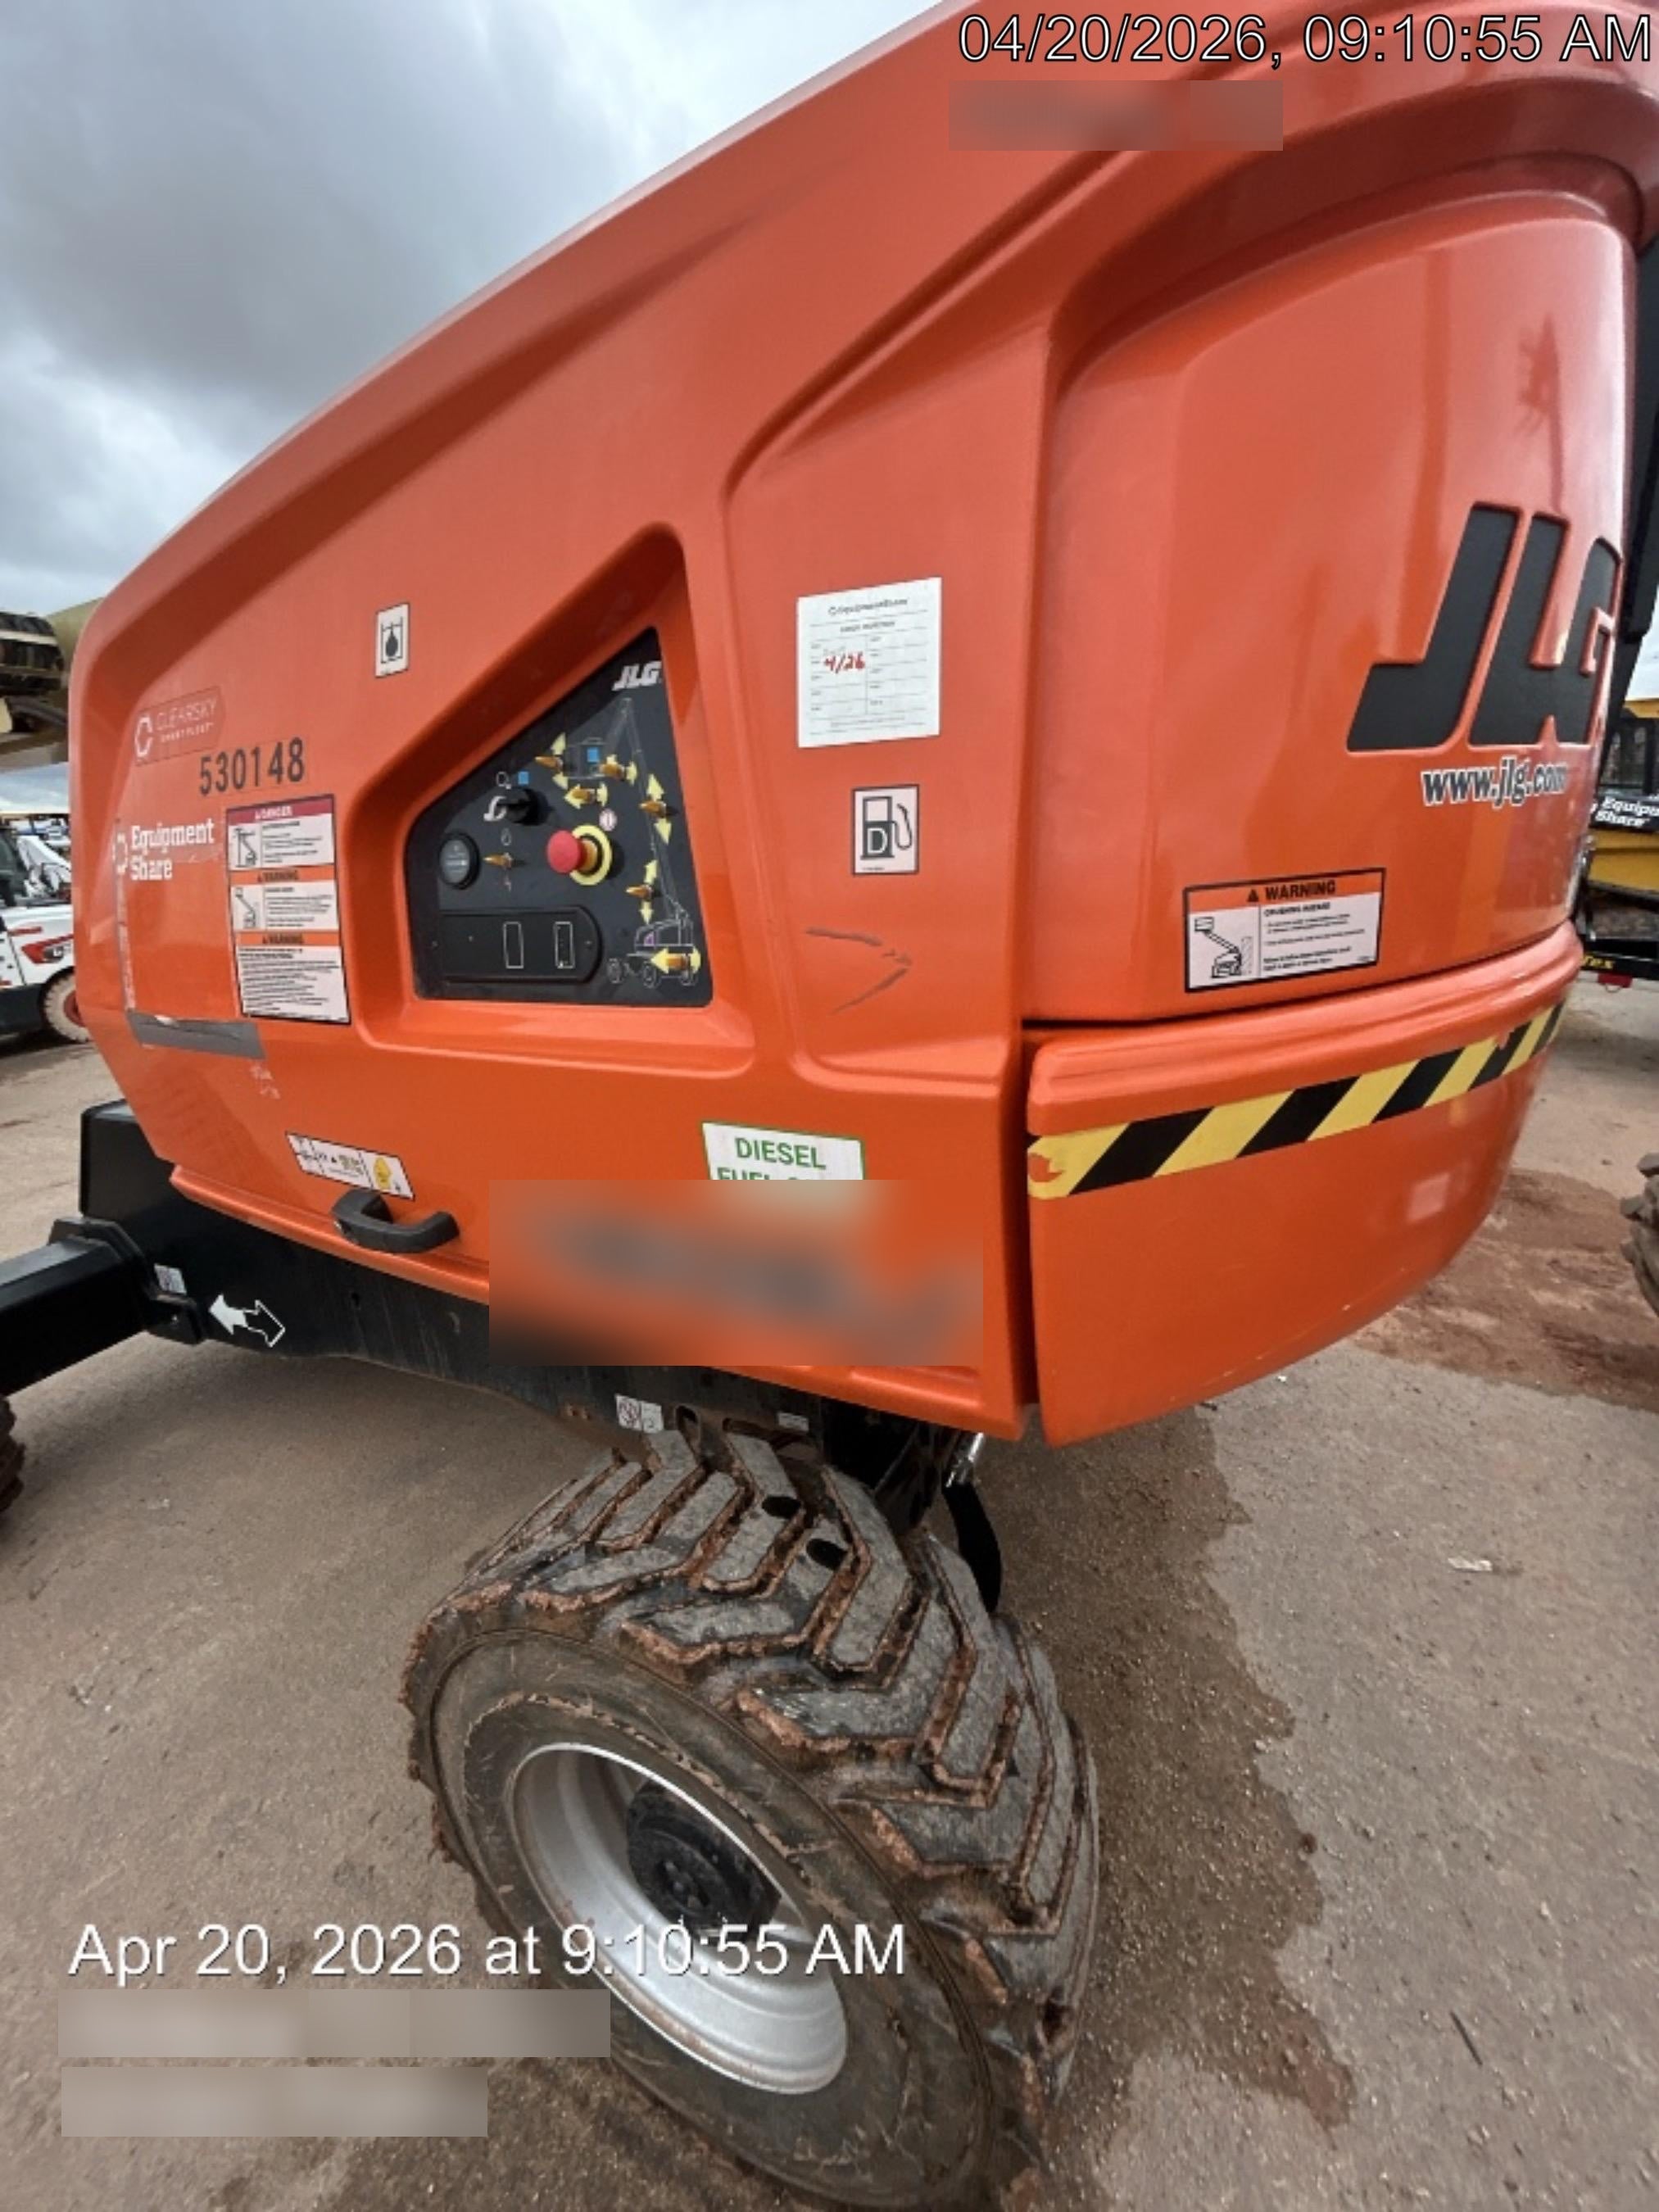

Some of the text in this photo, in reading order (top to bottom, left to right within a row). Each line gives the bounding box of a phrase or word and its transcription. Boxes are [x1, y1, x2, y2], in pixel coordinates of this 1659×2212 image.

[1348, 502, 1625, 752] JLG
[611, 661, 661, 691] JLG
[199, 737, 305, 796] 530148
[1421, 757, 1567, 809] www.jlg.com
[130, 818, 215, 854] Equipment
[130, 854, 173, 881] Share
[1266, 880, 1335, 900] WARNING
[735, 1137, 827, 1170] DIESEL
[716, 1167, 772, 1180] FU
